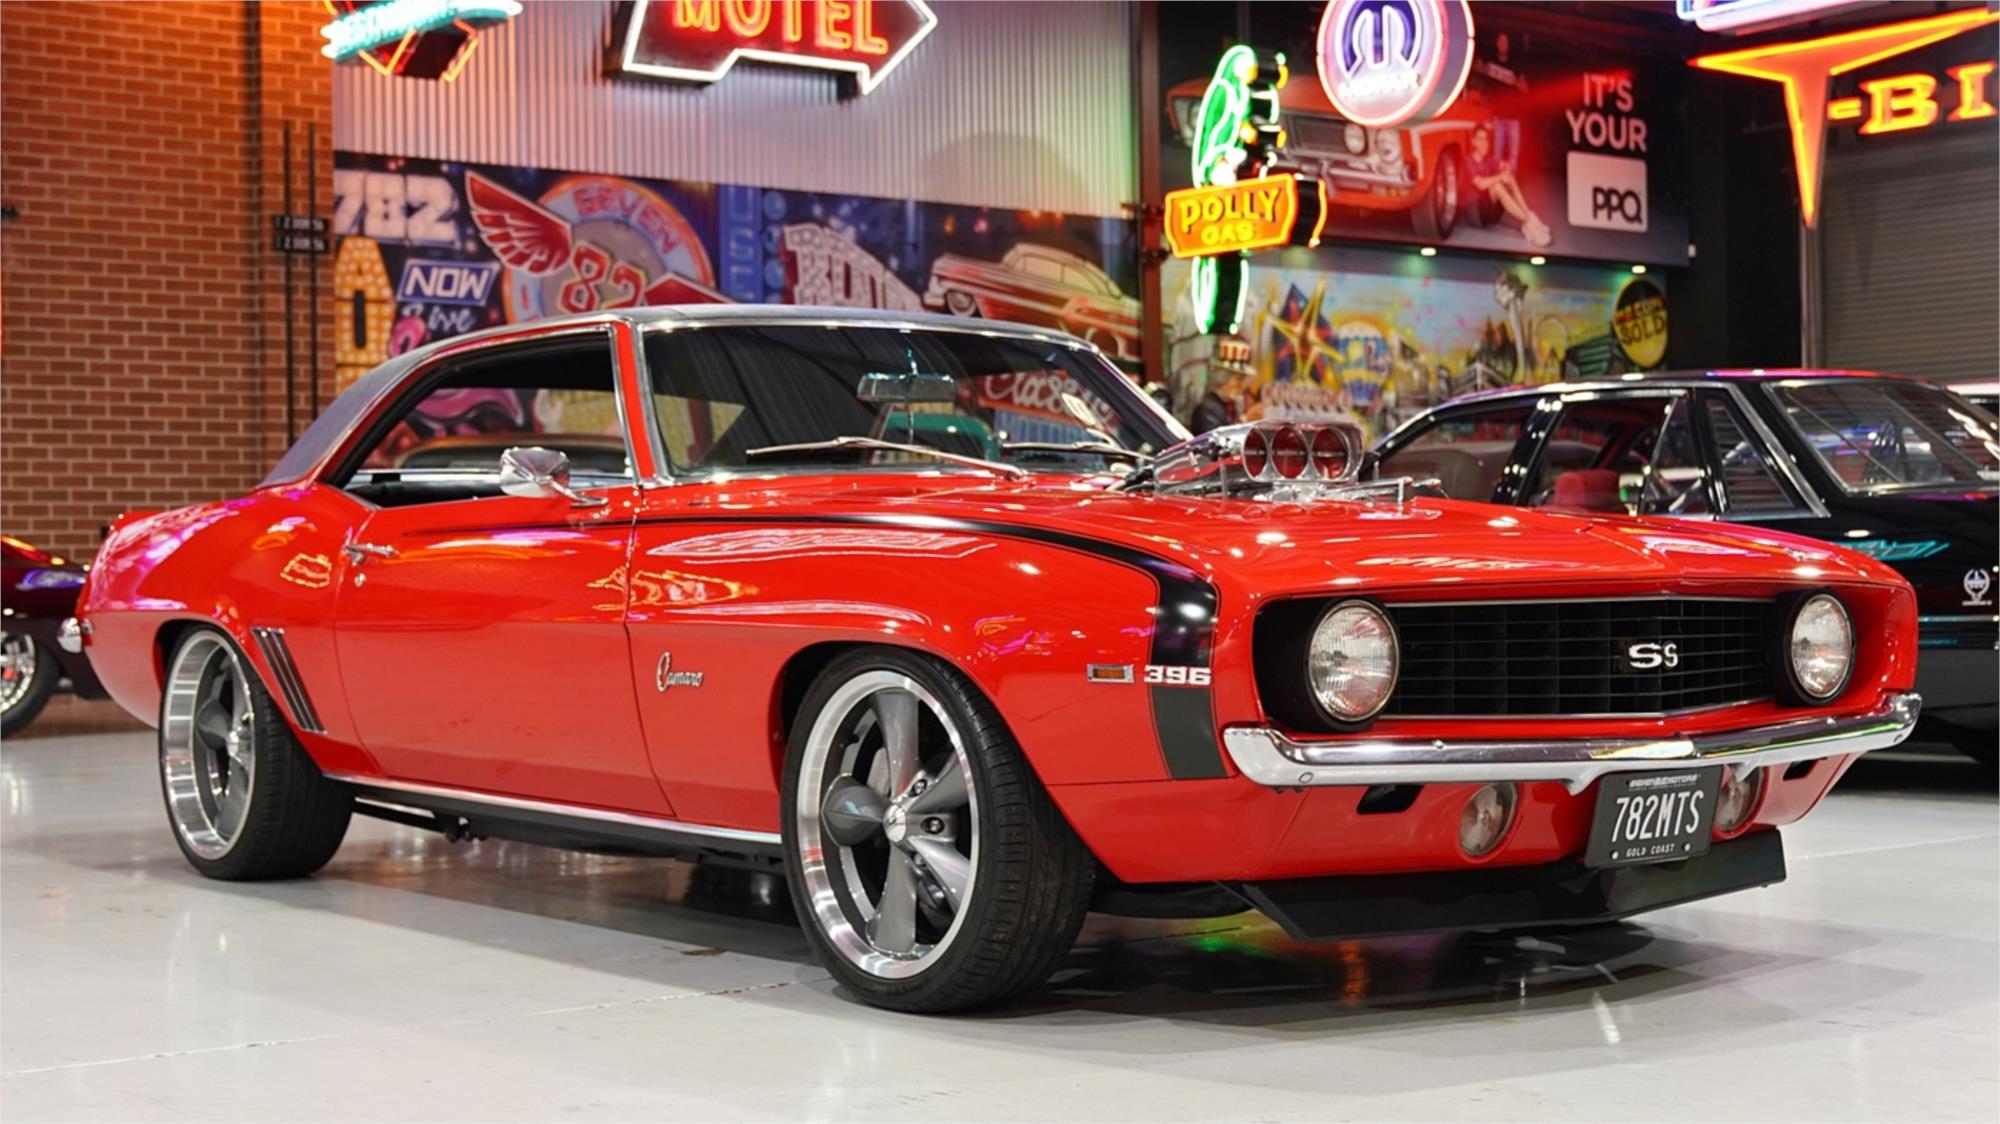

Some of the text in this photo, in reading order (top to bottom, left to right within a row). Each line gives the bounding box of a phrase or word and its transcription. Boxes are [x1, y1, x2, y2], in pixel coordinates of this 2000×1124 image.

[1584, 71, 1634, 112] IT'S
[1565, 109, 1647, 152] YOUR
[333, 171, 457, 242] 782
[1178, 186, 1281, 234] POLLY
[1593, 186, 1643, 225] PPQ
[1200, 220, 1255, 246] GAS
[404, 266, 490, 299] NOW
[558, 244, 648, 312] 82
[1144, 664, 1212, 686] 396
[1628, 643, 1679, 668] SS
[1612, 790, 1705, 842] 782MTS
[1626, 843, 1677, 858] GOLD COAST
